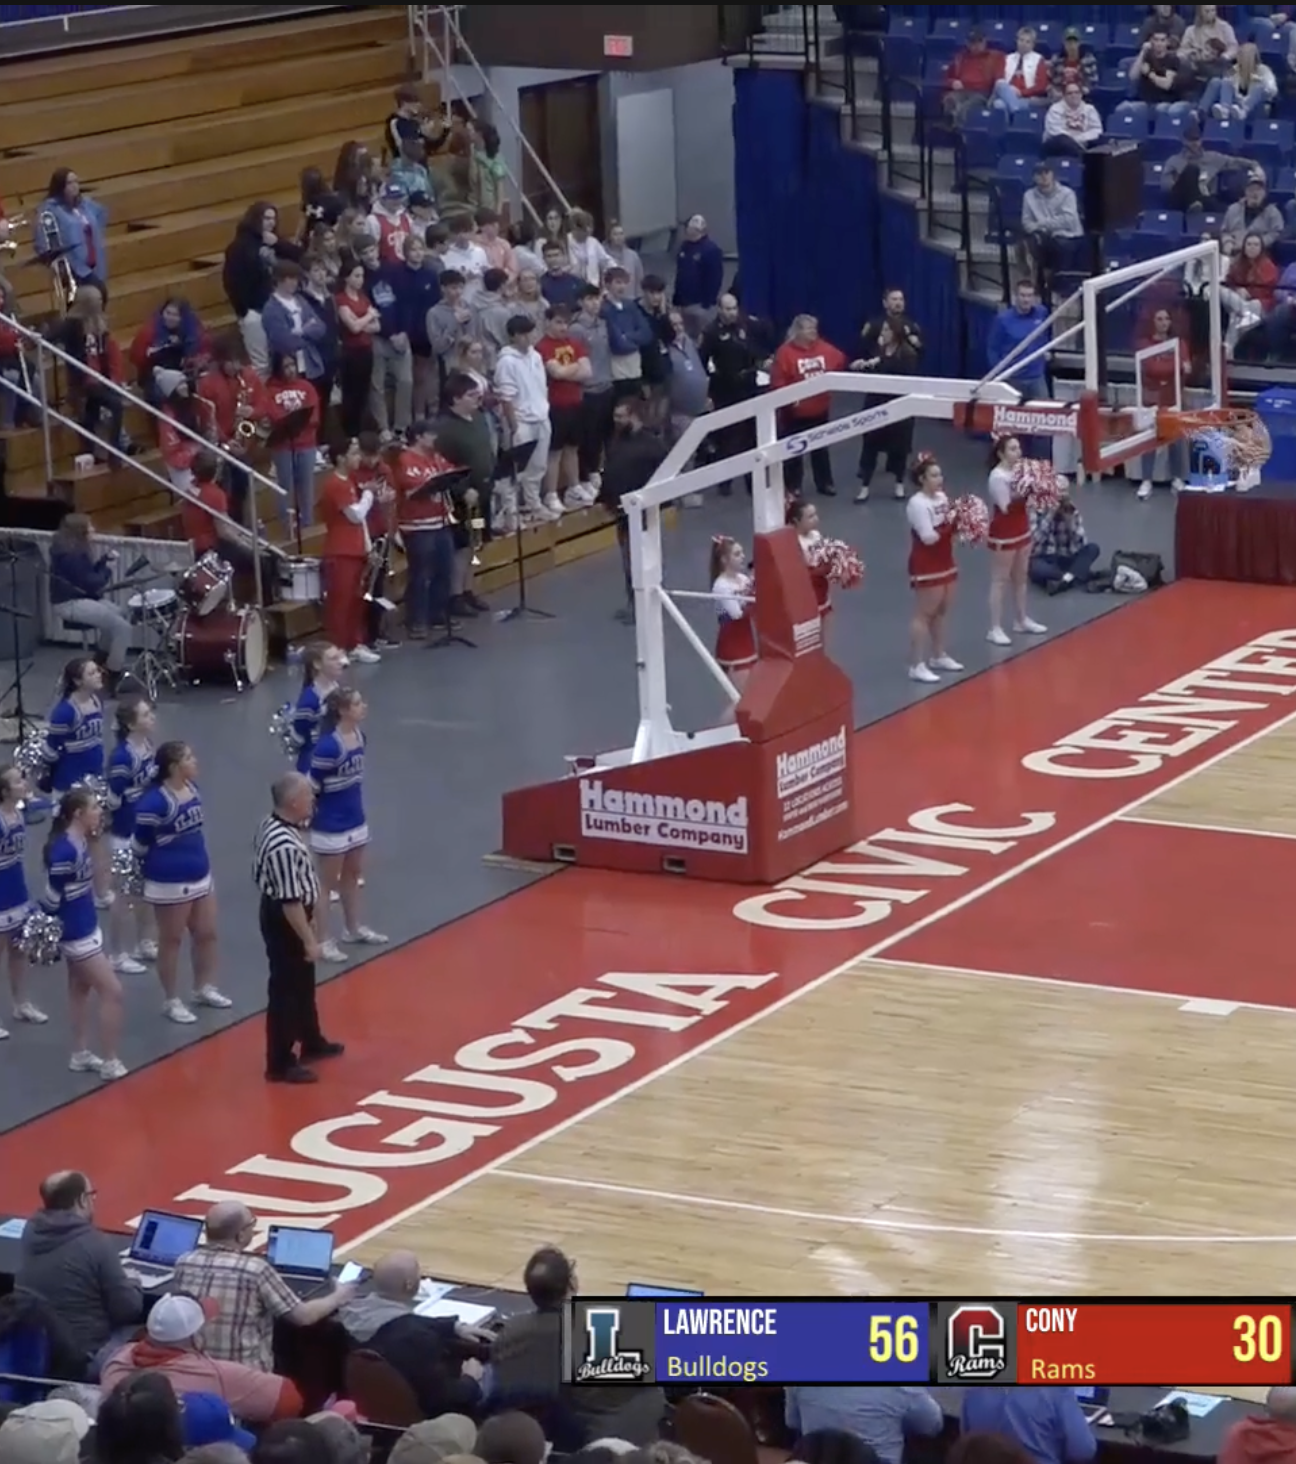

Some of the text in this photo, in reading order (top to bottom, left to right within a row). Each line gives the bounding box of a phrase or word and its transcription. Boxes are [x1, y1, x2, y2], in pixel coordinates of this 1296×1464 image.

[993, 405, 1078, 427] Hammond
[776, 724, 847, 778] Hammond
[580, 778, 748, 828] Hammond
[585, 813, 745, 851] Lumber Company
[732, 803, 1056, 930] CIVIC
